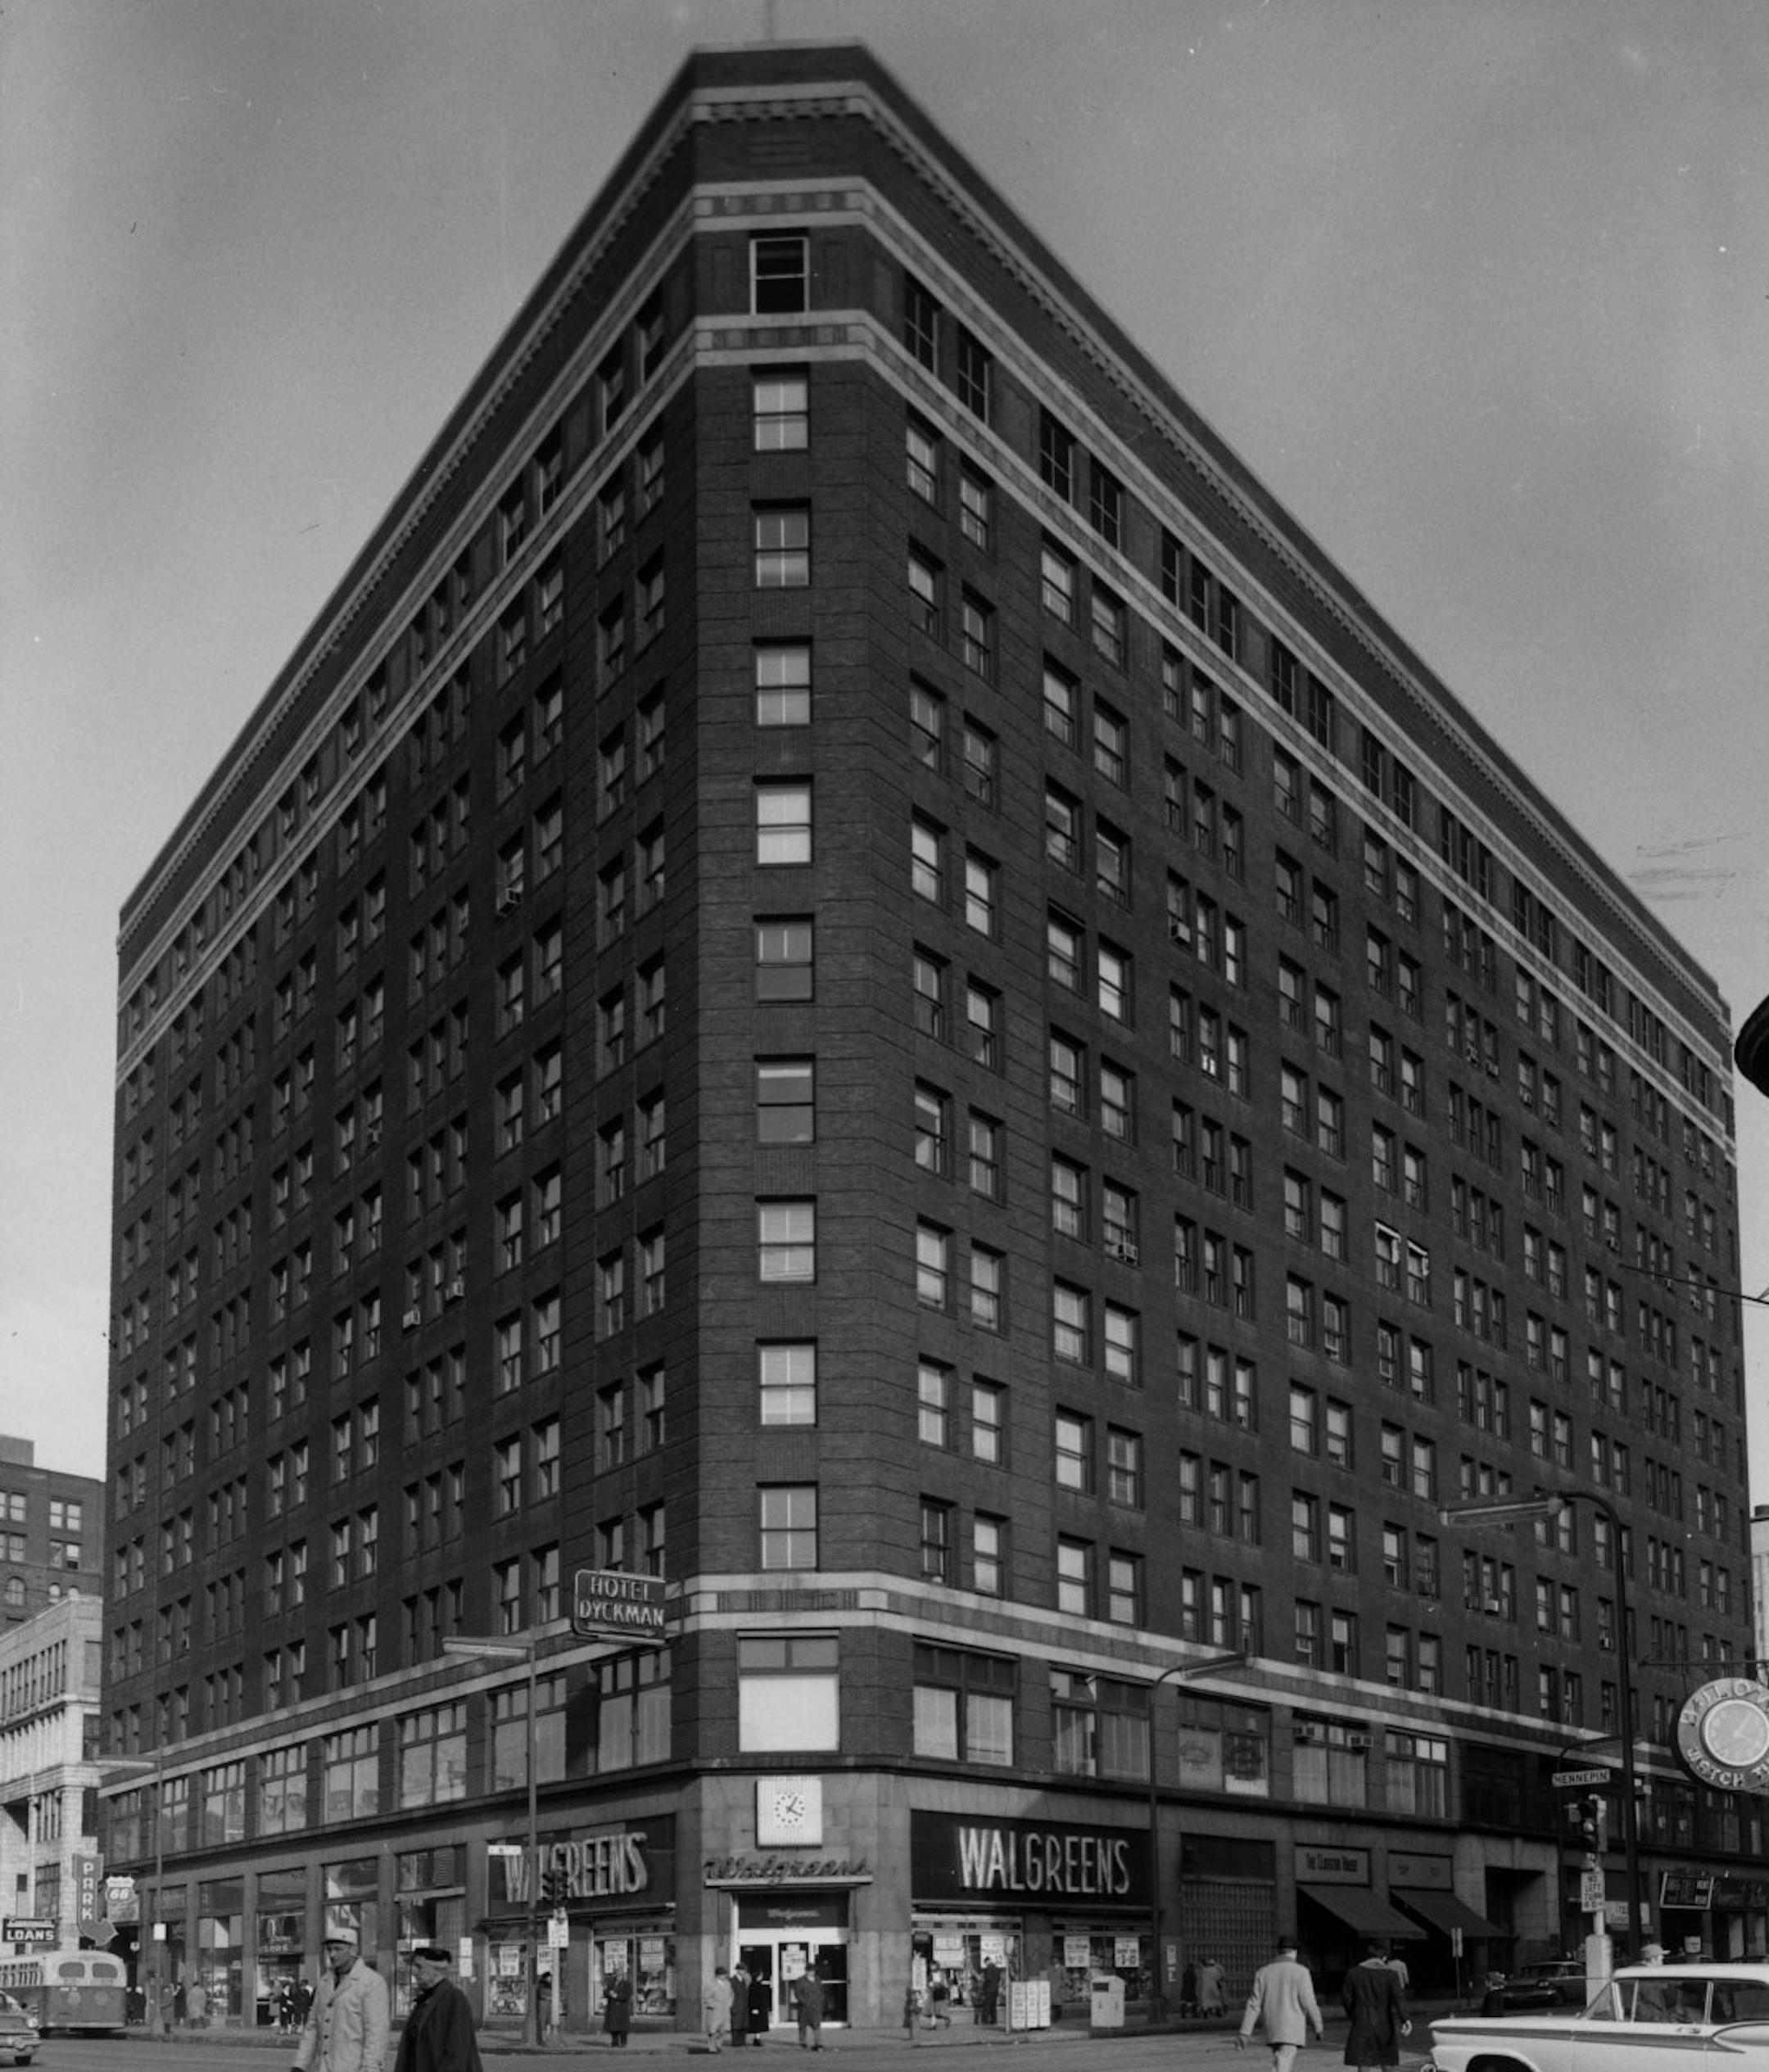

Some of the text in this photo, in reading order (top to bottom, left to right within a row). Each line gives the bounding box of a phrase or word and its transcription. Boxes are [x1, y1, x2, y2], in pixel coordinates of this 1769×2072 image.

[590, 1576, 654, 1603] HOTEL
[579, 1599, 664, 1626] DYCKMAN
[1554, 1771, 1608, 1786] HENNEPIN
[704, 1856, 874, 1884] Walgreens
[959, 1826, 1129, 1894] WALGREENS
[83, 1862, 93, 1920] PARK
[110, 1888, 129, 1899] 66
[7, 1929, 54, 1941] LOANS
